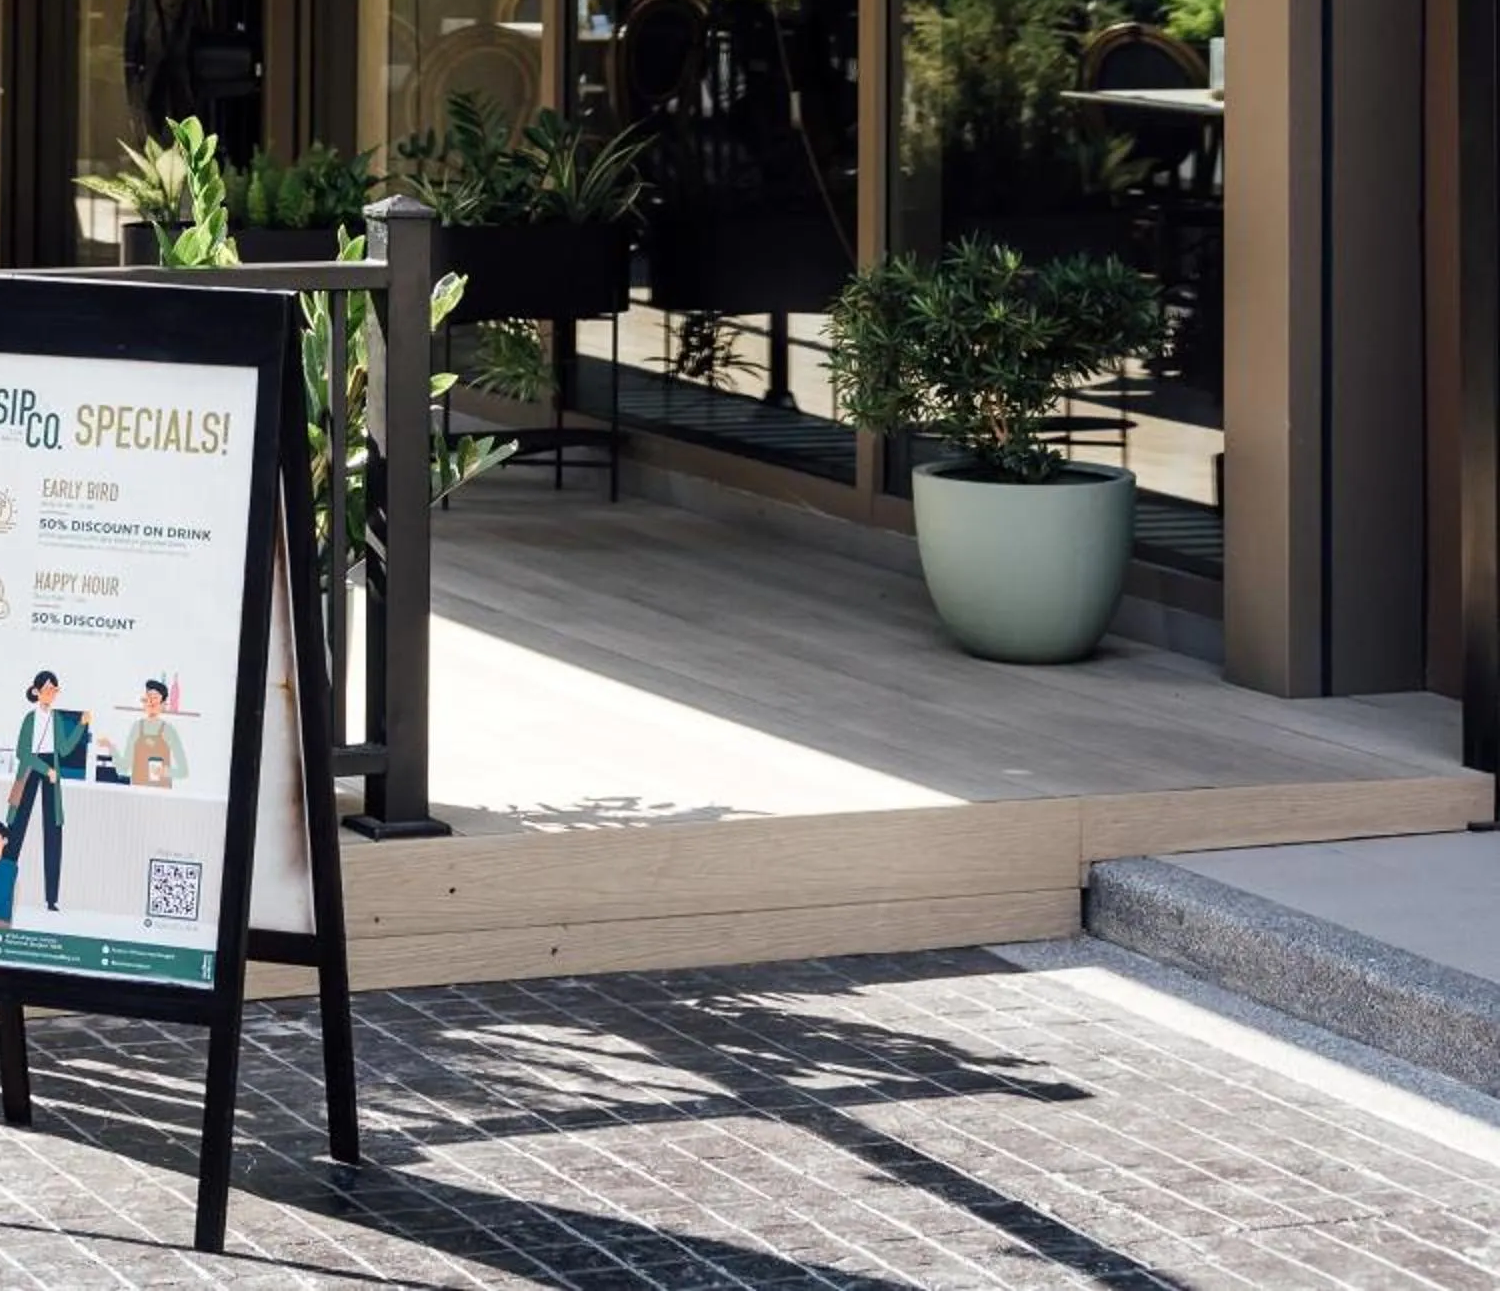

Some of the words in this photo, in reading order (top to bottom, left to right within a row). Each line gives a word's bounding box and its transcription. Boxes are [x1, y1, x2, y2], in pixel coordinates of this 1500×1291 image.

[25, 411, 63, 451] CO.
[74, 404, 231, 456] SPECIALS!
[42, 477, 84, 500] EARLY
[87, 481, 120, 502] BIRD
[38, 517, 68, 531] 50%
[71, 519, 141, 537] DISCOUNT
[143, 525, 163, 538] ON
[167, 526, 213, 542] DRINK
[34, 571, 79, 594] HAPPY
[81, 573, 120, 597] HOUR
[31, 612, 61, 625] 50%
[63, 613, 137, 631] DISCOUNT
